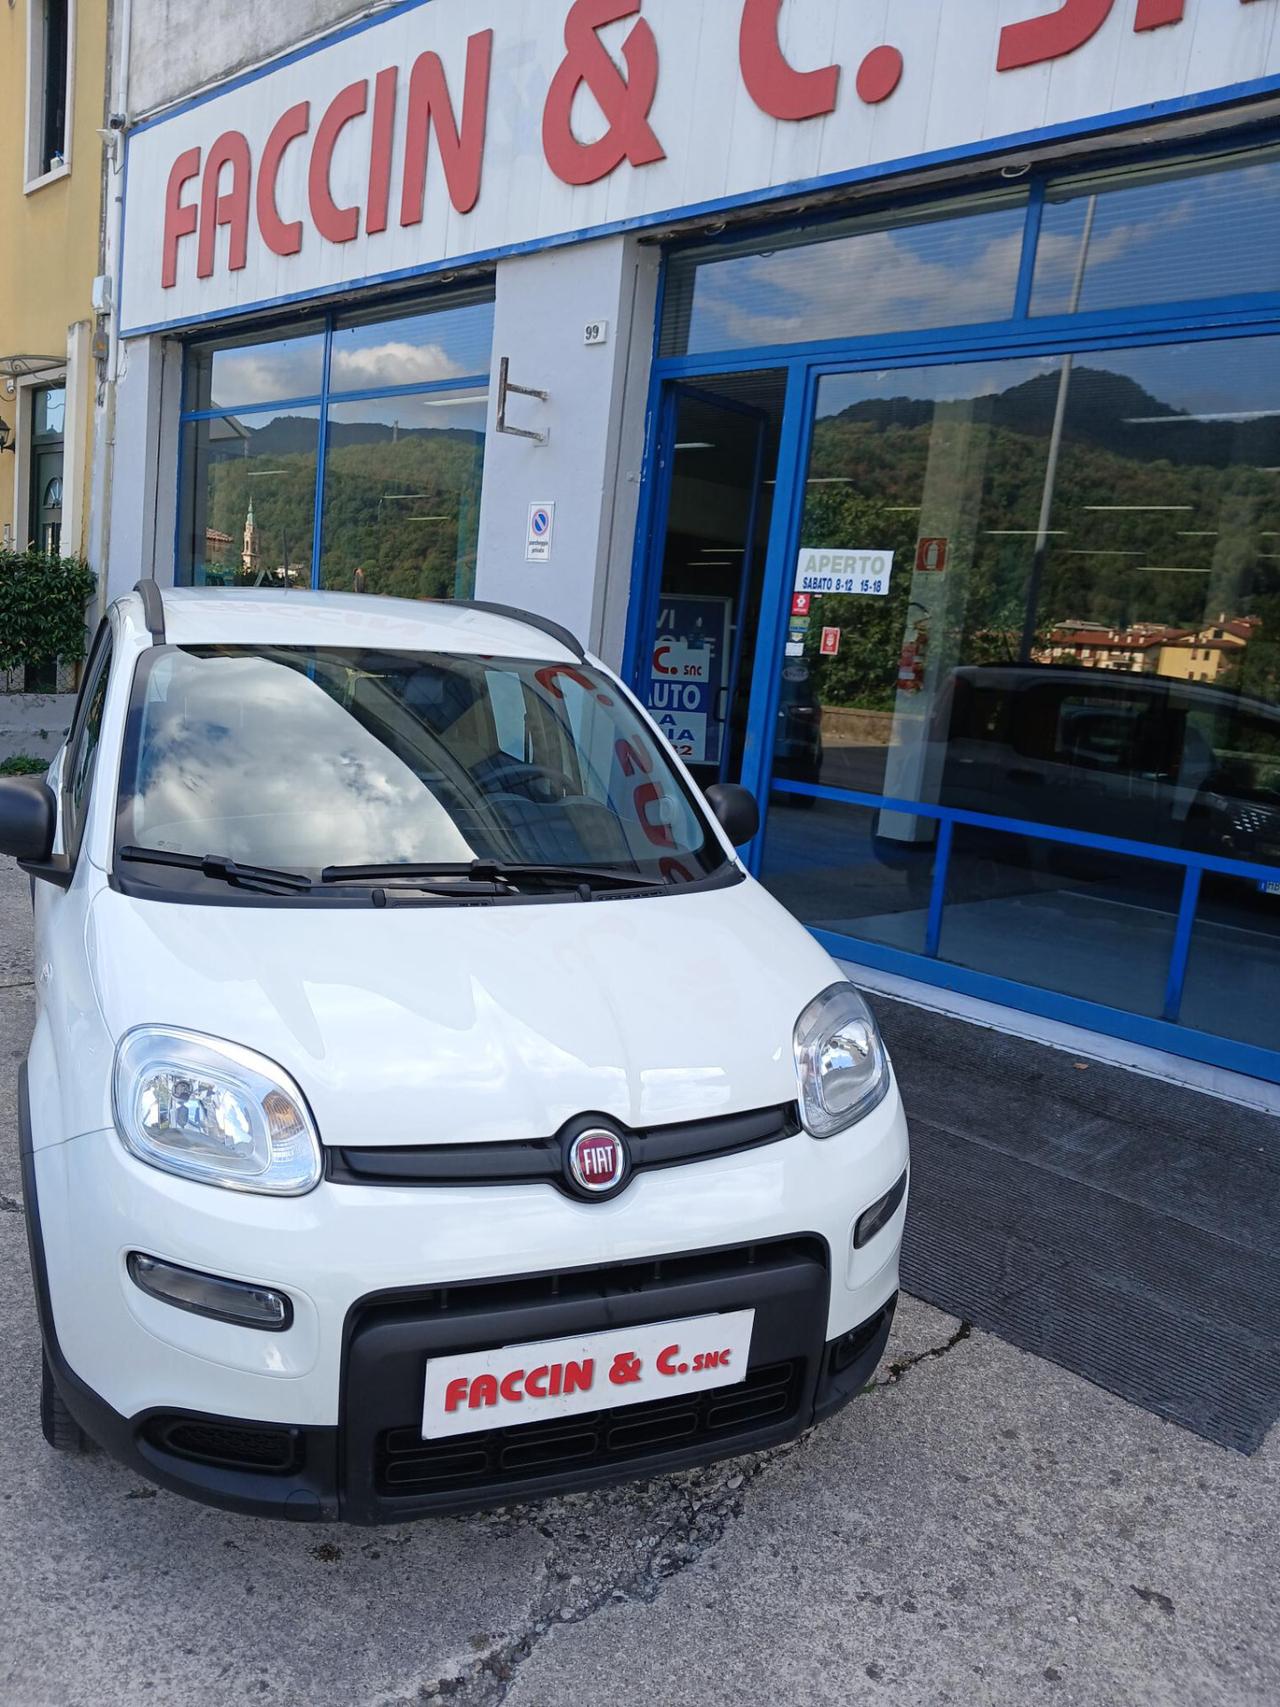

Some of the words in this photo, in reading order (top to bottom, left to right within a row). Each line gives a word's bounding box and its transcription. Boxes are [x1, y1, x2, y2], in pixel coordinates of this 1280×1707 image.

[161, 28, 494, 289] FACCIN
[541, 0, 667, 186] &
[585, 324, 600, 340] 99
[804, 554, 885, 575] APERTO
[802, 577, 832, 590] SABATO
[835, 578, 853, 591] 8-12
[860, 580, 882, 592] 15-18
[583, 1145, 613, 1175] FIAT
[444, 1358, 594, 1412] FACCIN
[609, 1352, 641, 1385] &
